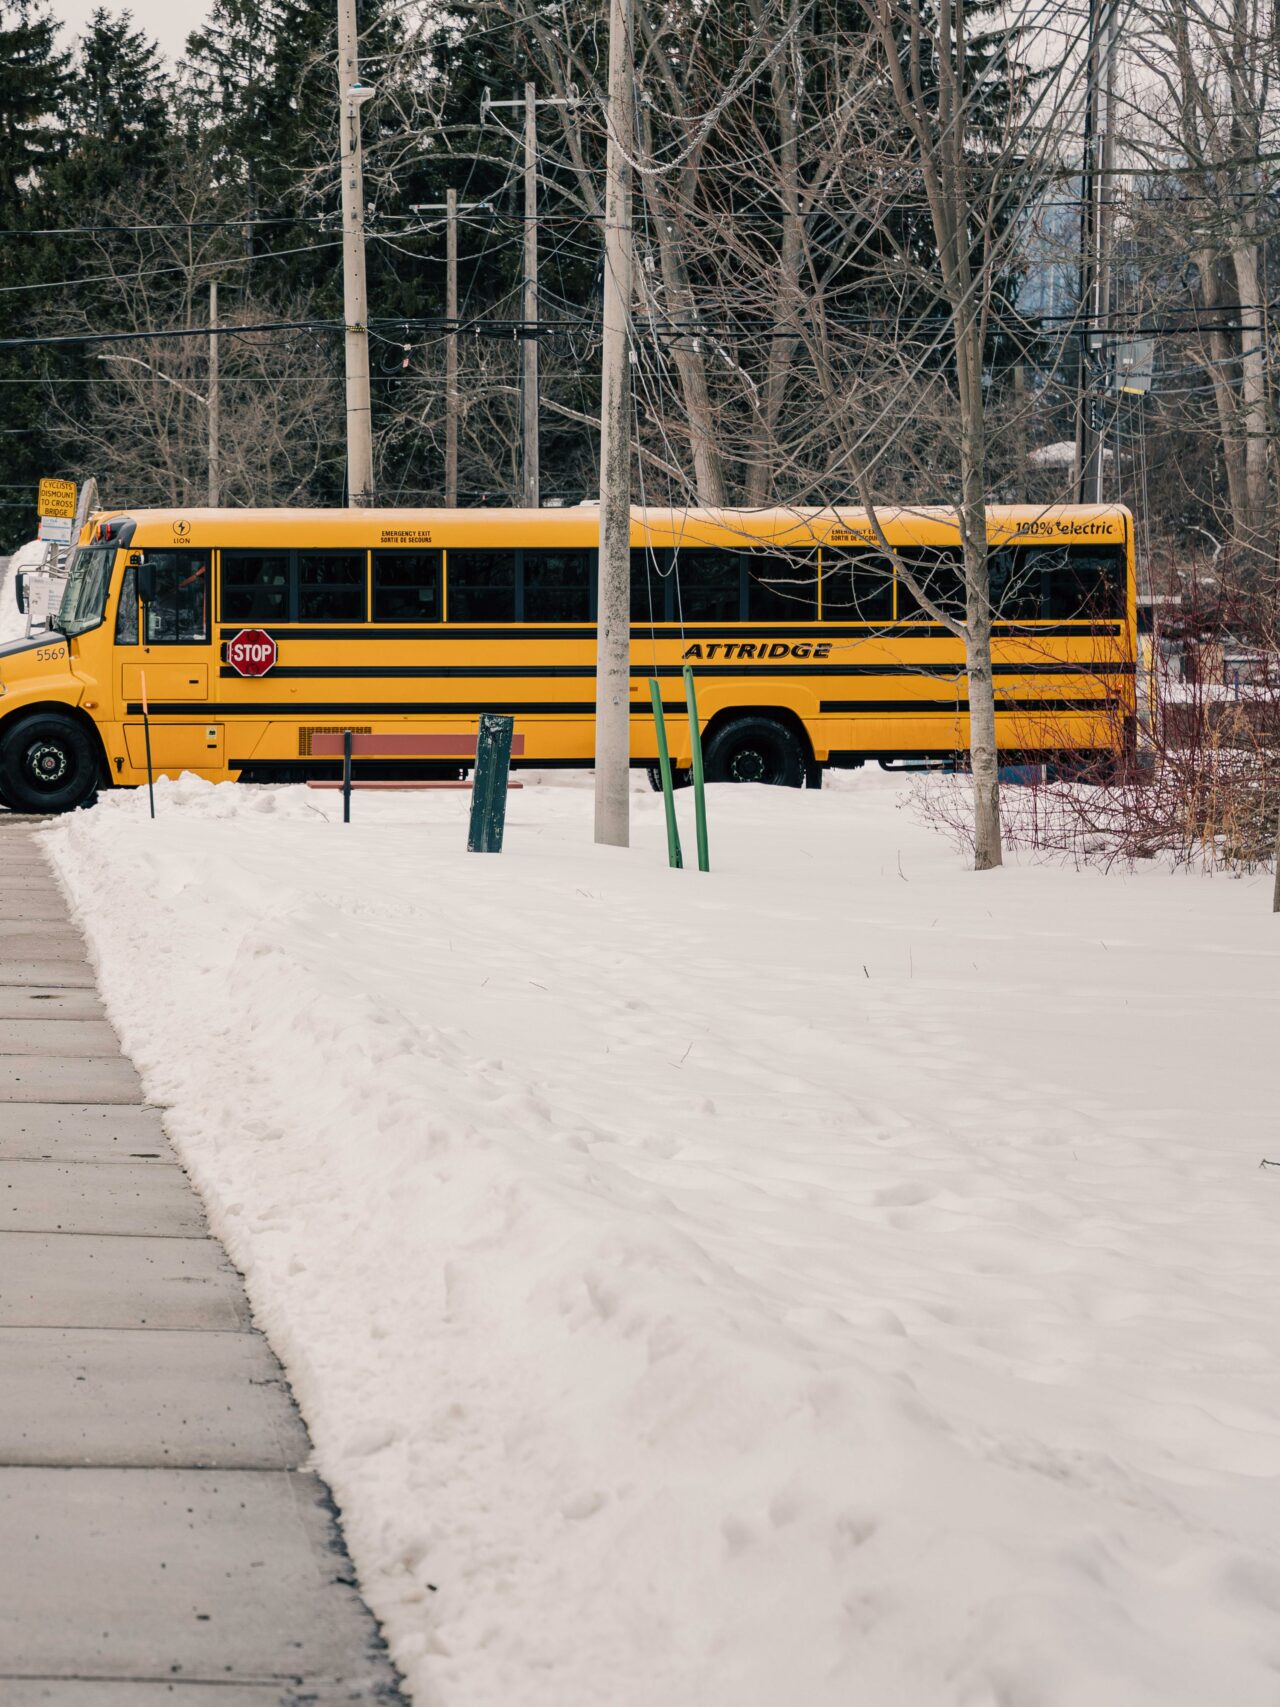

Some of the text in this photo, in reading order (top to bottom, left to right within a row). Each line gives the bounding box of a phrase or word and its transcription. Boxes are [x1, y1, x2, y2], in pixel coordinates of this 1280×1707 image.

[43, 481, 73, 490] CYCLISTS
[41, 490, 74, 499] DISMOUNT
[51, 499, 73, 508] CROSS
[44, 508, 68, 516] BRIDGE
[1016, 521, 1113, 535] 100% electric
[36, 647, 65, 661] 5569
[233, 643, 272, 662] STOP
[681, 642, 833, 659] ATTRIDGE
